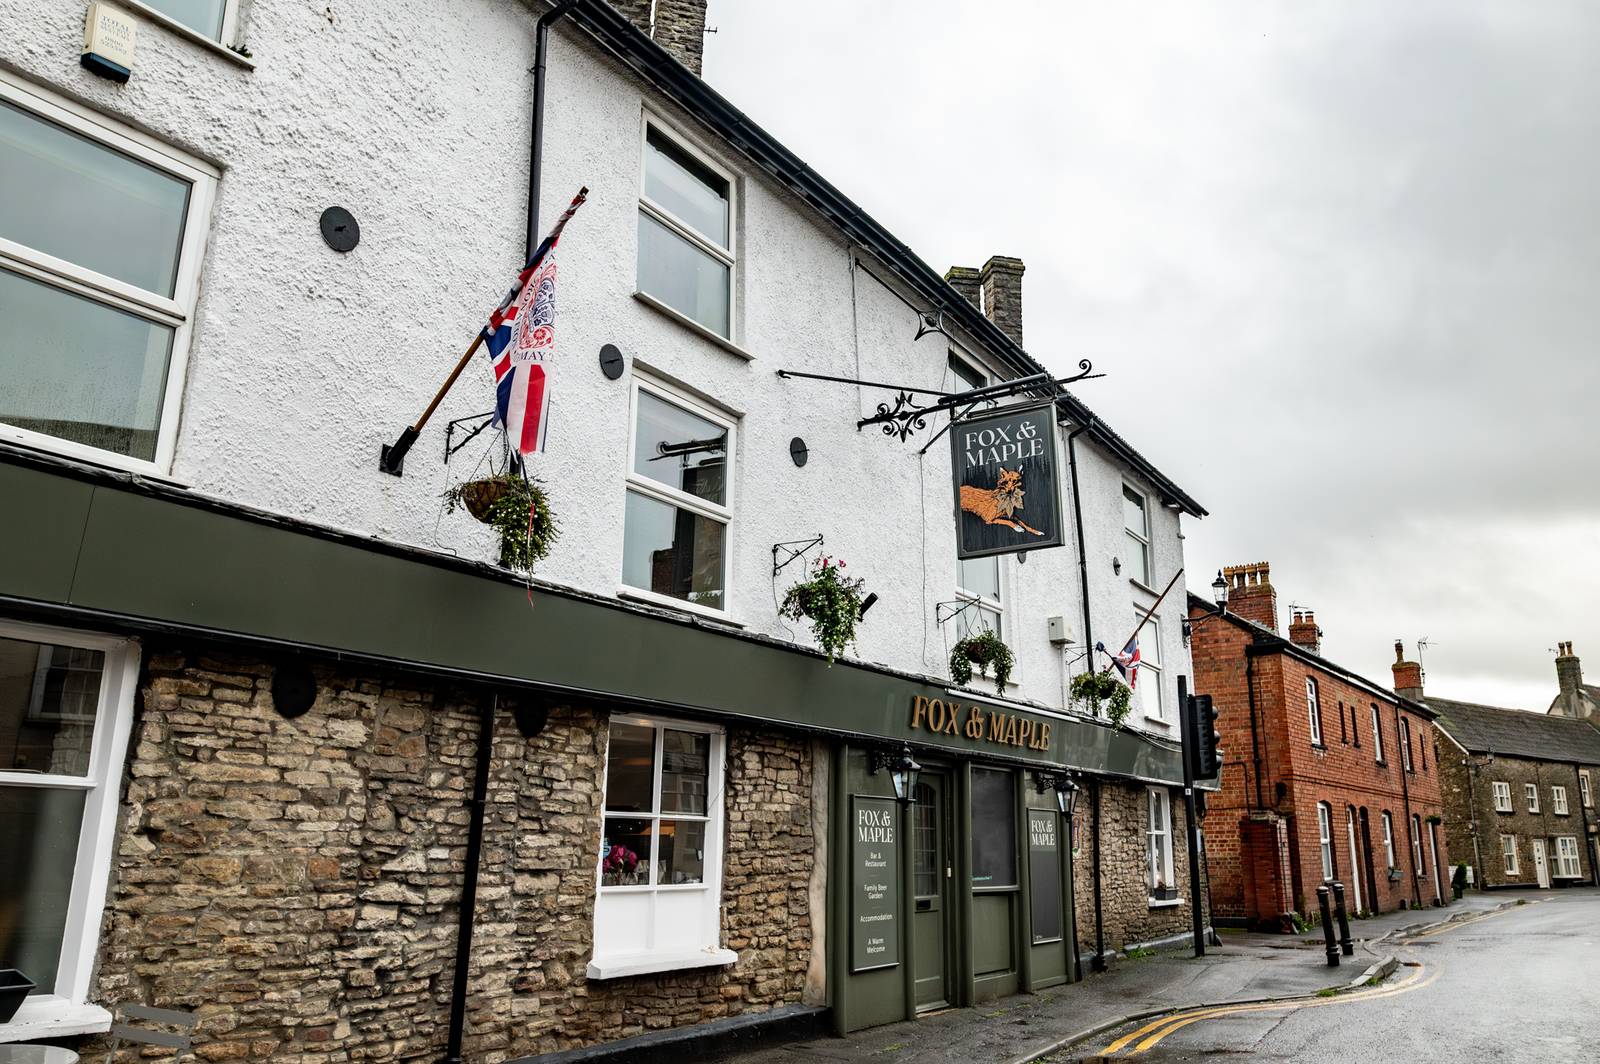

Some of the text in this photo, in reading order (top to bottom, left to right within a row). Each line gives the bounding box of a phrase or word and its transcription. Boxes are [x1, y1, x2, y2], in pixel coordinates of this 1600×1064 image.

[101, 15, 129, 32] TOTAL
[965, 421, 1036, 450] FOX &
[965, 438, 1044, 468] MAPLE
[911, 695, 1051, 751] FOX & MAPLE
[858, 809, 891, 827] FOX &
[1031, 820, 1053, 833] FOX &
[858, 826, 893, 843] MAPLE
[1031, 833, 1055, 846] MAPLE
[863, 884, 877, 892] Family
[868, 892, 883, 900] Garden
[860, 914, 893, 922] Accommodation
[866, 946, 886, 954] Welcome
